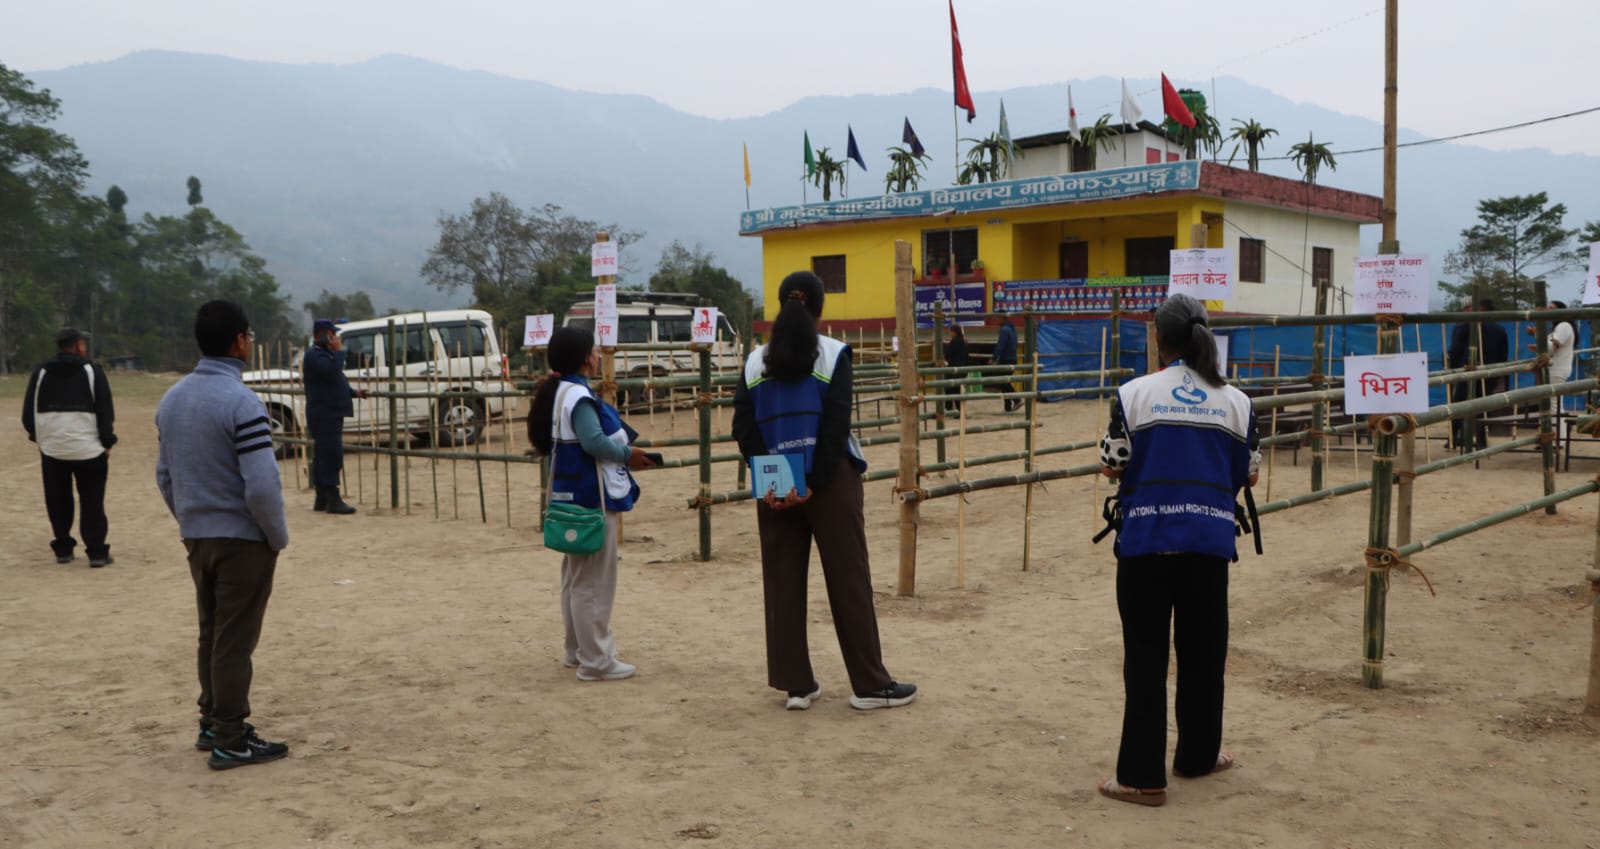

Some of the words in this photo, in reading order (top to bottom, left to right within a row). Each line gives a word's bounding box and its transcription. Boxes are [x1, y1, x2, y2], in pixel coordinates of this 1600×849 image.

[836, 194, 923, 212] माध्यमिक
[931, 185, 1012, 205] विद्यालय
[1172, 273, 1199, 285] मतदान
[1202, 268, 1227, 287] केन्द्र
[1358, 371, 1411, 397] भित्र
[1129, 506, 1157, 518] NATIONAL
[1159, 504, 1185, 515] HUMAN
[1185, 503, 1209, 516] RIGHTS
